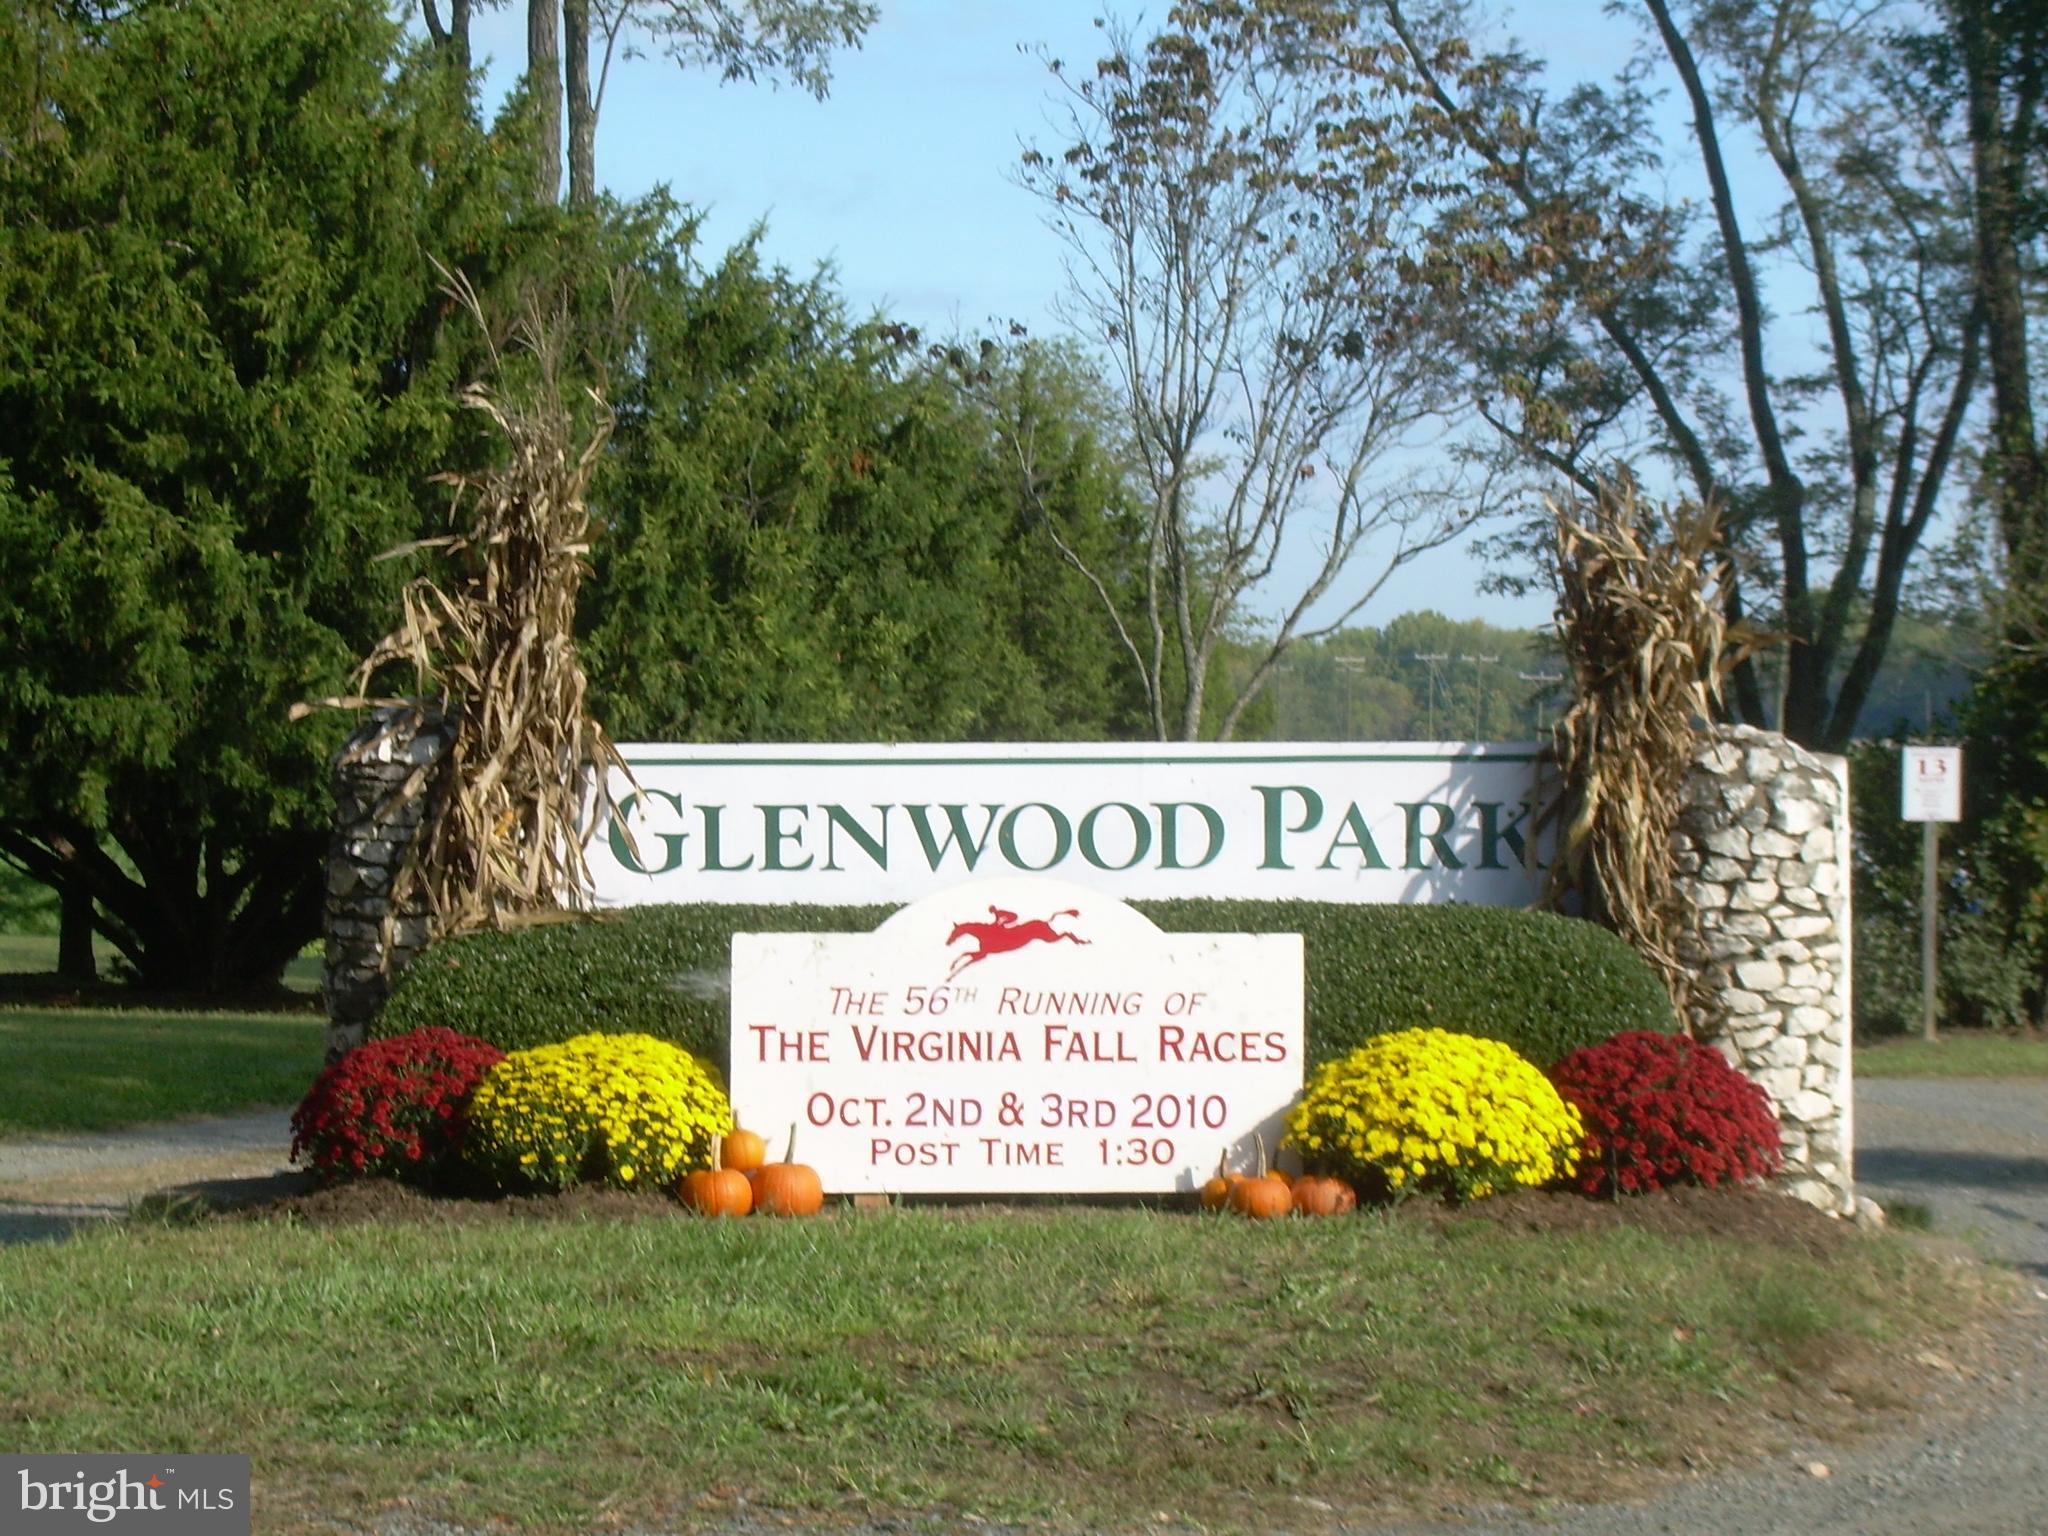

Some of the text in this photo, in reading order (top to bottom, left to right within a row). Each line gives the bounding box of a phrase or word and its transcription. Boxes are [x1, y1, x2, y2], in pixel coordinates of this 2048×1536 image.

[608, 785, 1546, 874] GLENWOOD PARK
[830, 986, 1207, 1016] THE 56TH RUNNING OF
[749, 1024, 1287, 1063] THE VIRGINIA FALL RACES
[807, 1092, 1227, 1129] OCT. 2ND & 3RD 2010
[871, 1138, 1175, 1166] POST TIME 1:30
